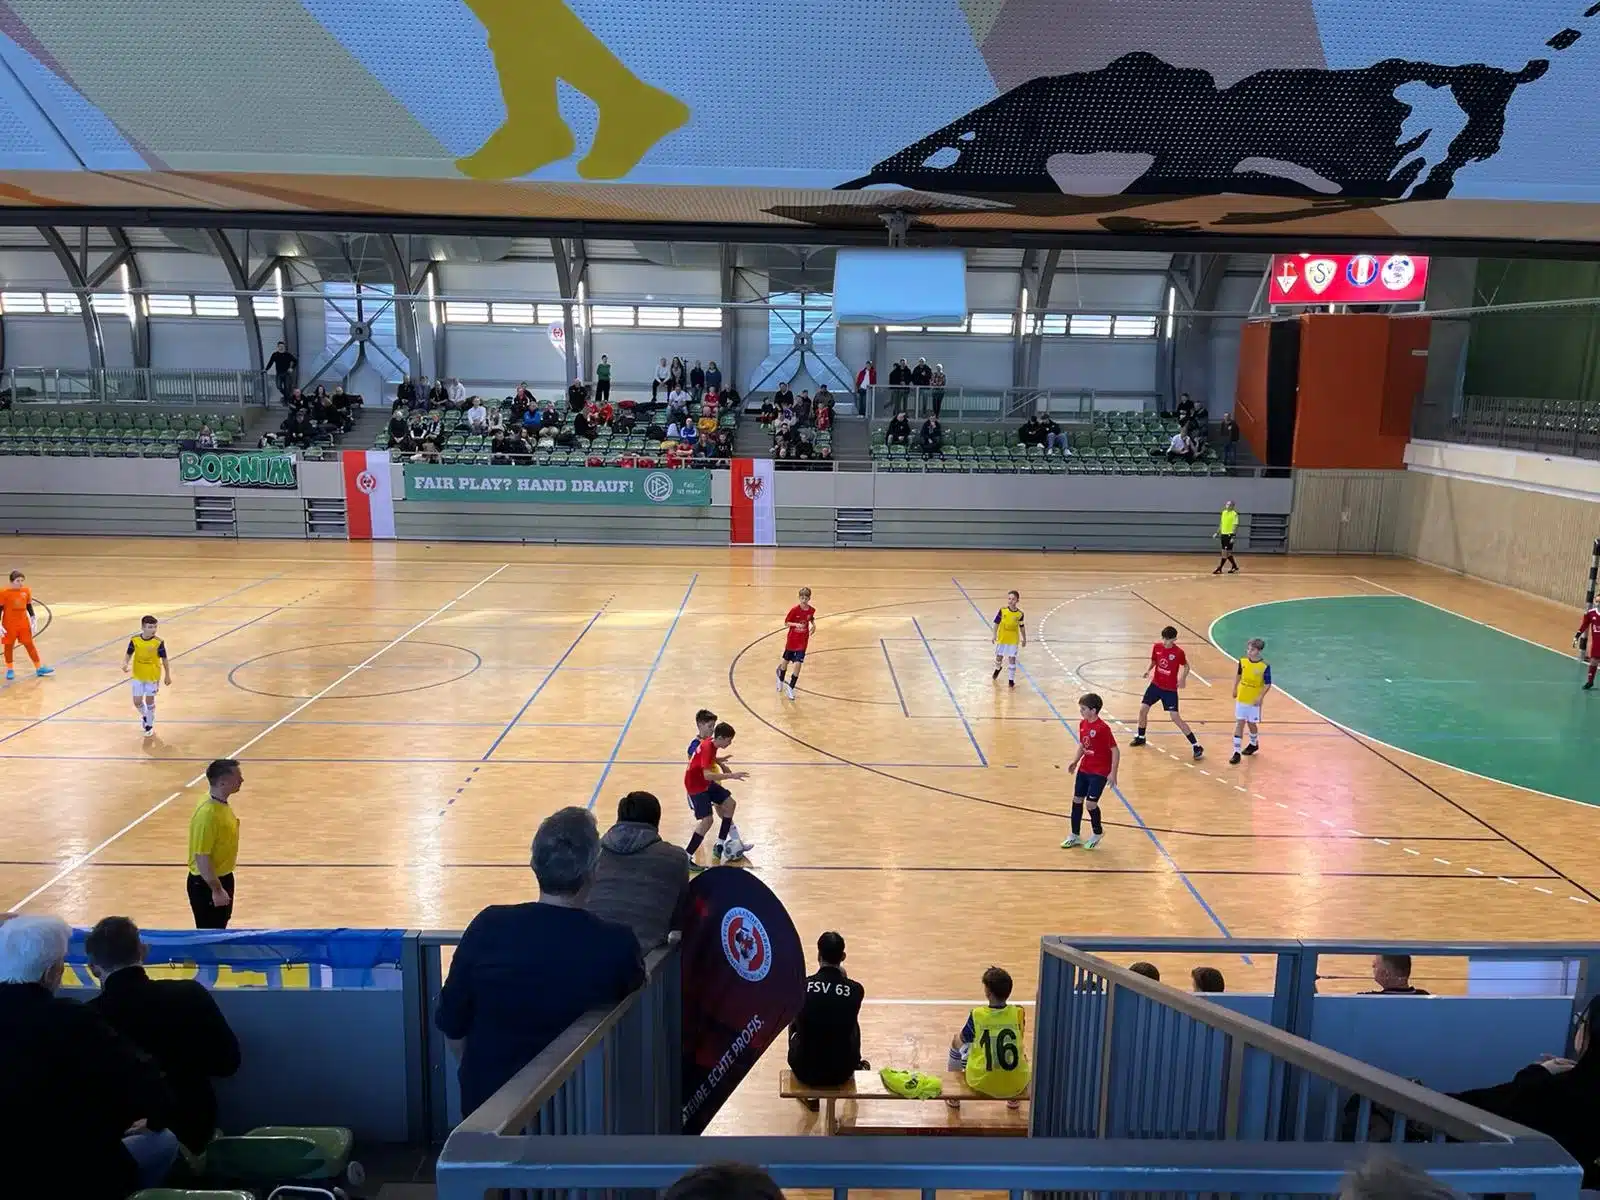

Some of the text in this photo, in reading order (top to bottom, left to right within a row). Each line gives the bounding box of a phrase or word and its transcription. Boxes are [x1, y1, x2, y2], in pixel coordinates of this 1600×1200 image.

[180, 452, 295, 485] BORNIM
[414, 477, 634, 492] FAIR PLAY? HAND DRAUF!
[806, 981, 851, 997] FSV 63
[707, 1049, 735, 1088] ECHTE
[731, 1014, 765, 1057] PROFIS.
[979, 1028, 1019, 1072] 16
